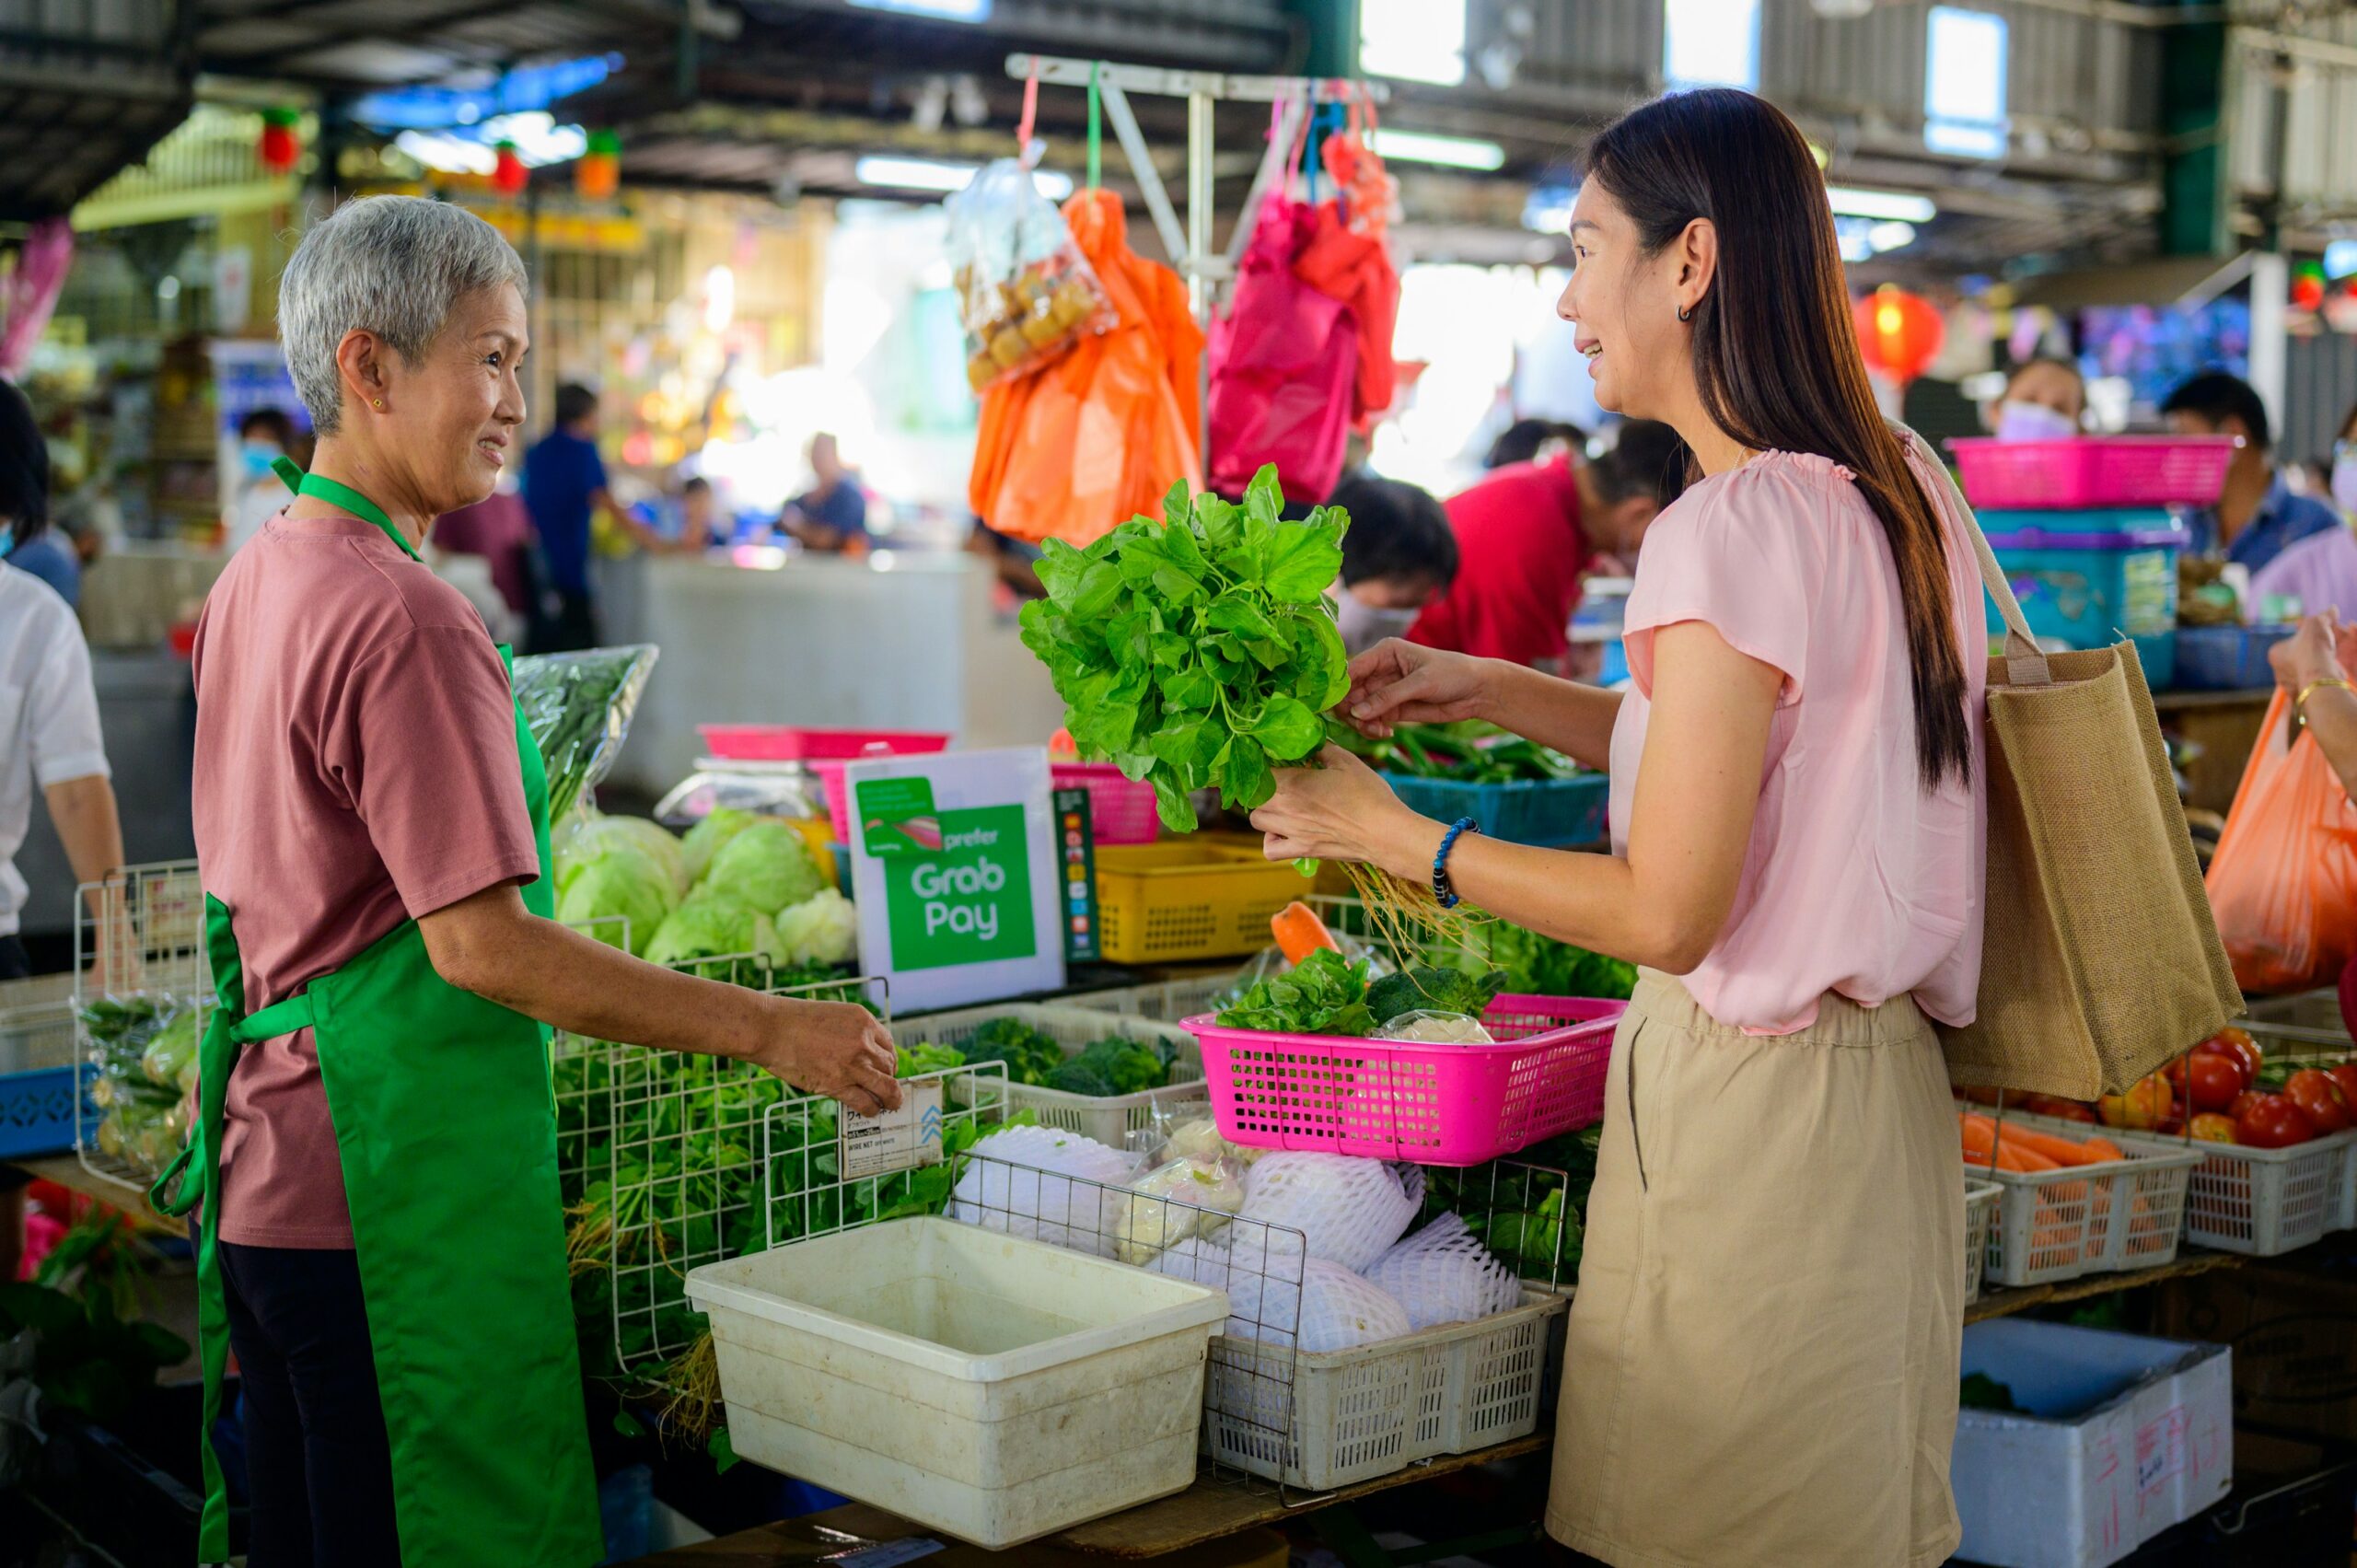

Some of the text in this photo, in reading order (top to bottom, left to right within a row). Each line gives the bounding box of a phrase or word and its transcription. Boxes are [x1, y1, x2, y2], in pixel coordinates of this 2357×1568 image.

[943, 829, 998, 852] prefer
[911, 855, 1004, 899] Grab
[925, 901, 998, 940] Pay
[848, 1143, 862, 1151] WIRE
[863, 1140, 873, 1148] NET
